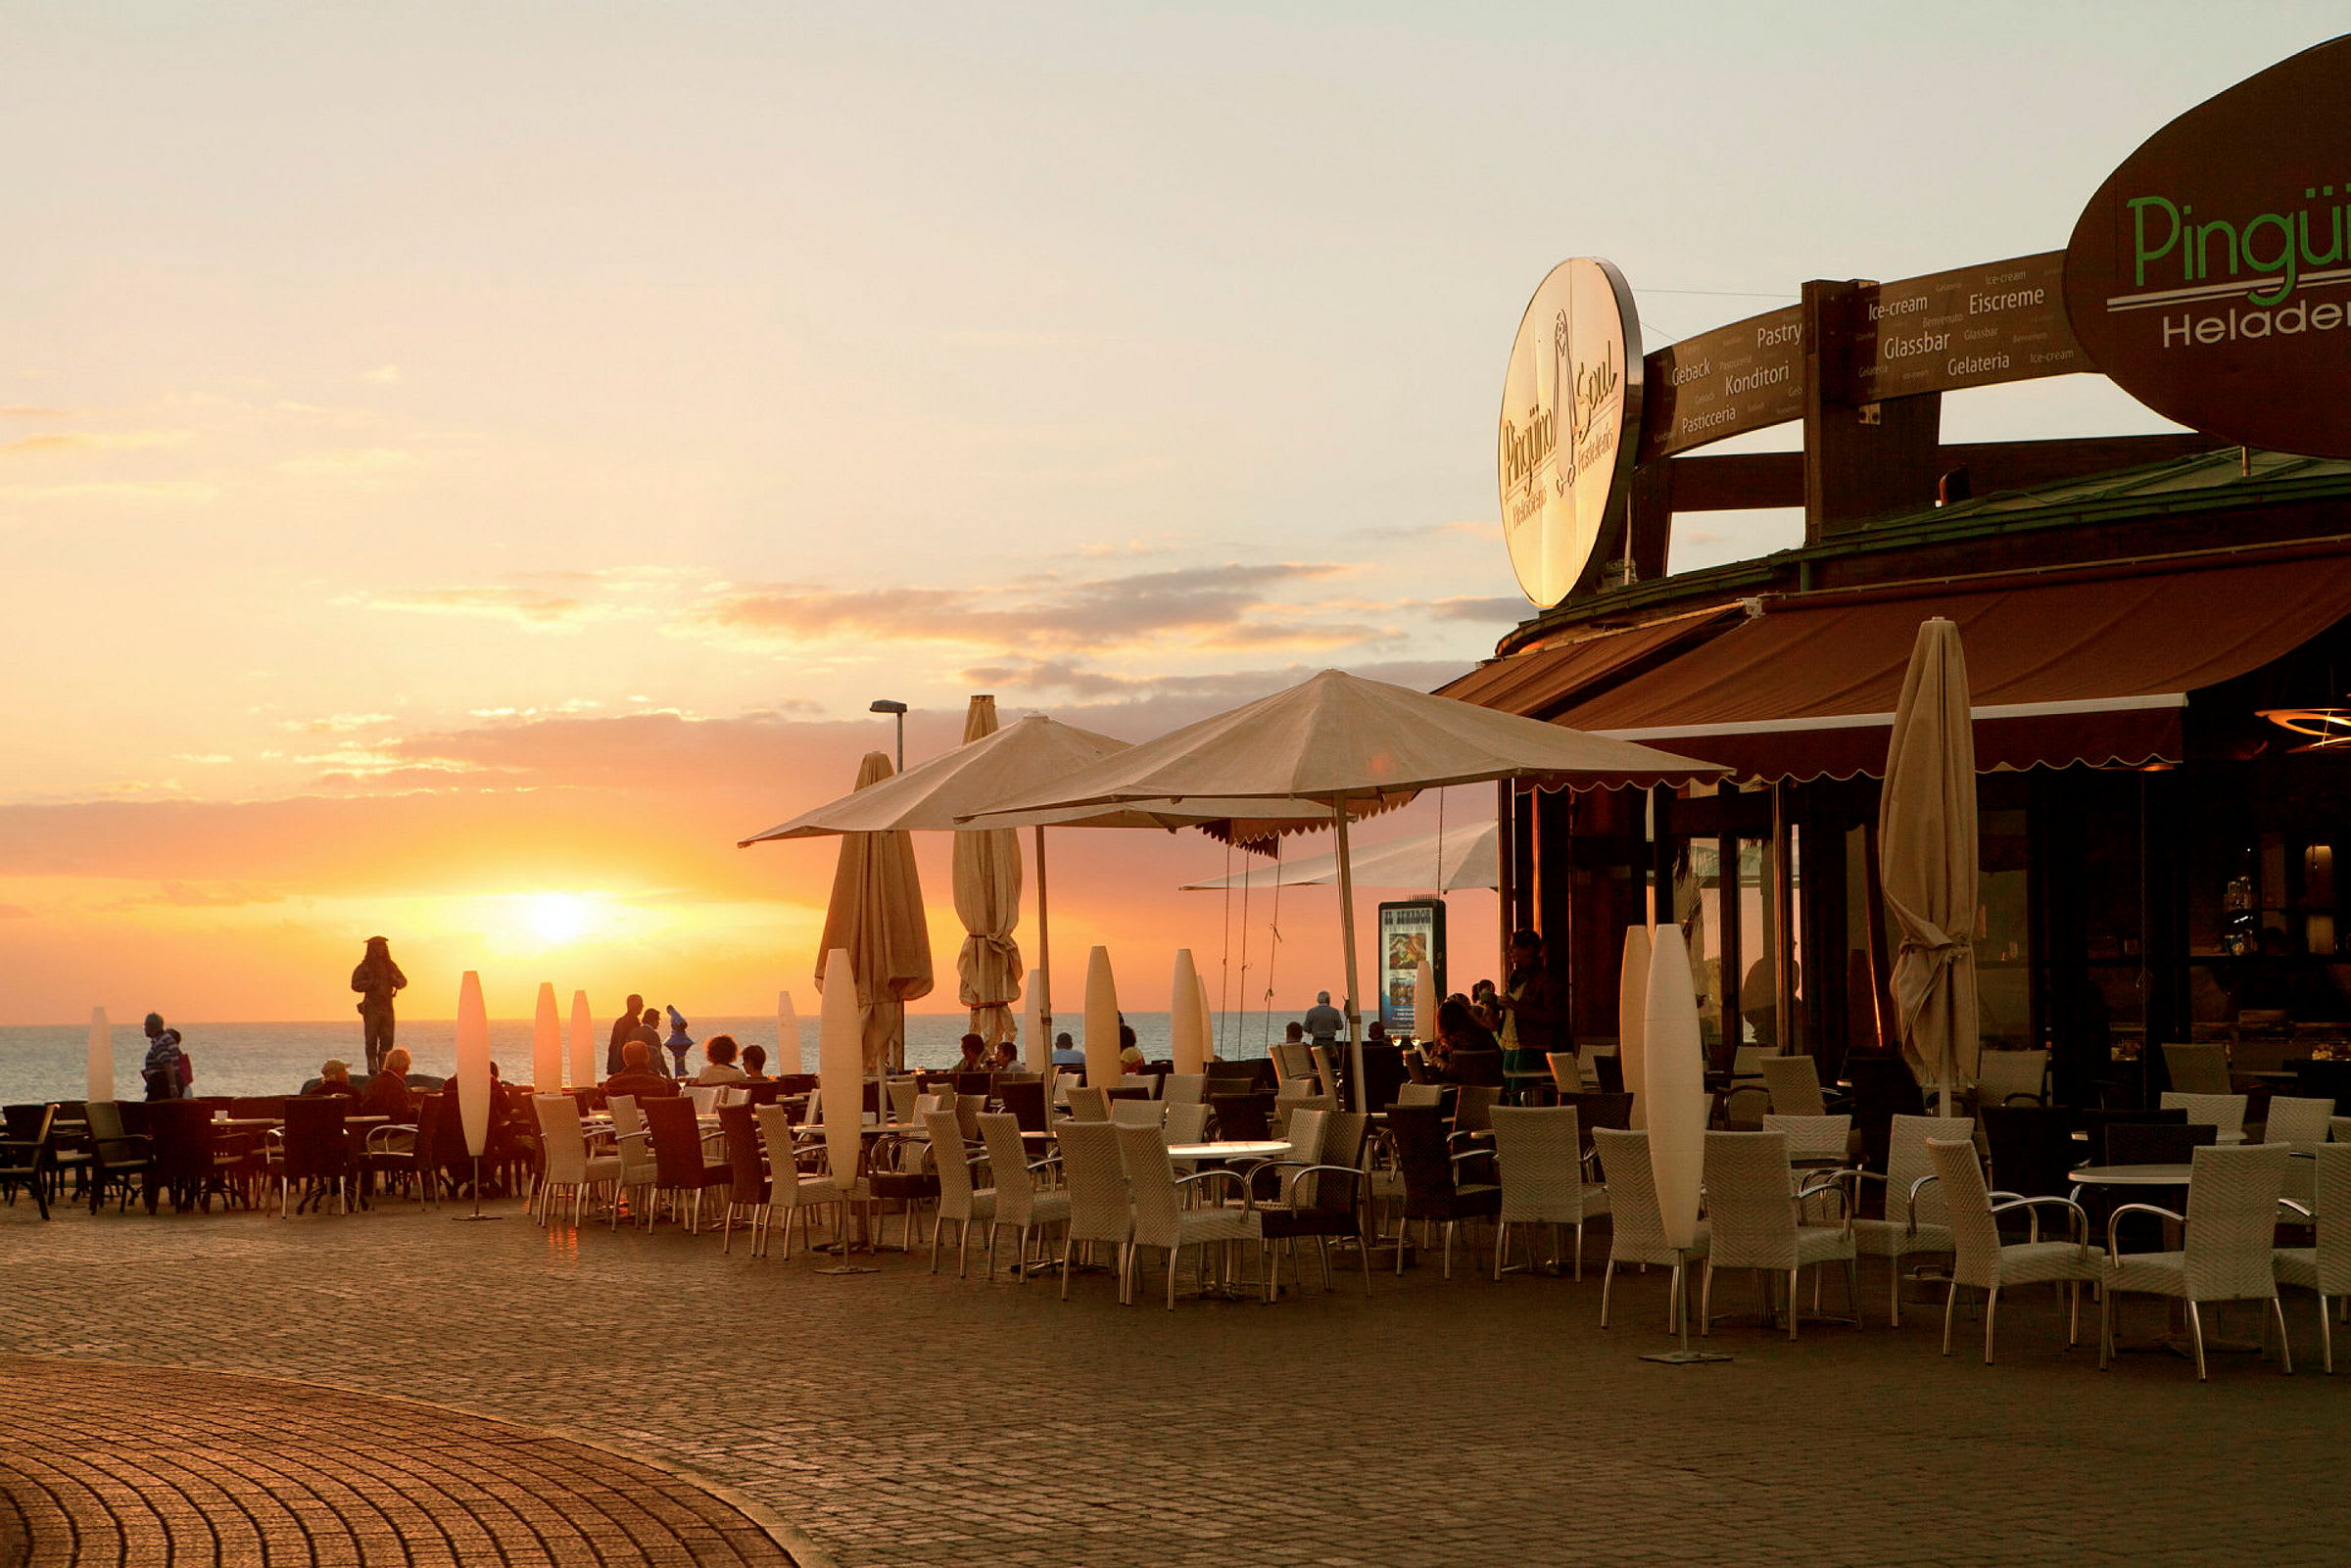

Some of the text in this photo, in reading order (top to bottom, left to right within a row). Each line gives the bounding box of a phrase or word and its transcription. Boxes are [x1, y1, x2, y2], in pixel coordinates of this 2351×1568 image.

[1868, 296, 1928, 321] Ice-cream
[1969, 288, 2044, 315] Eiscreme
[1757, 323, 1802, 349] Pastry
[1884, 331, 1950, 359] Glassbar
[1947, 353, 2010, 376] Gelateria
[1725, 360, 1791, 397] Konditori
[1682, 404, 1736, 435] Pasticceria
